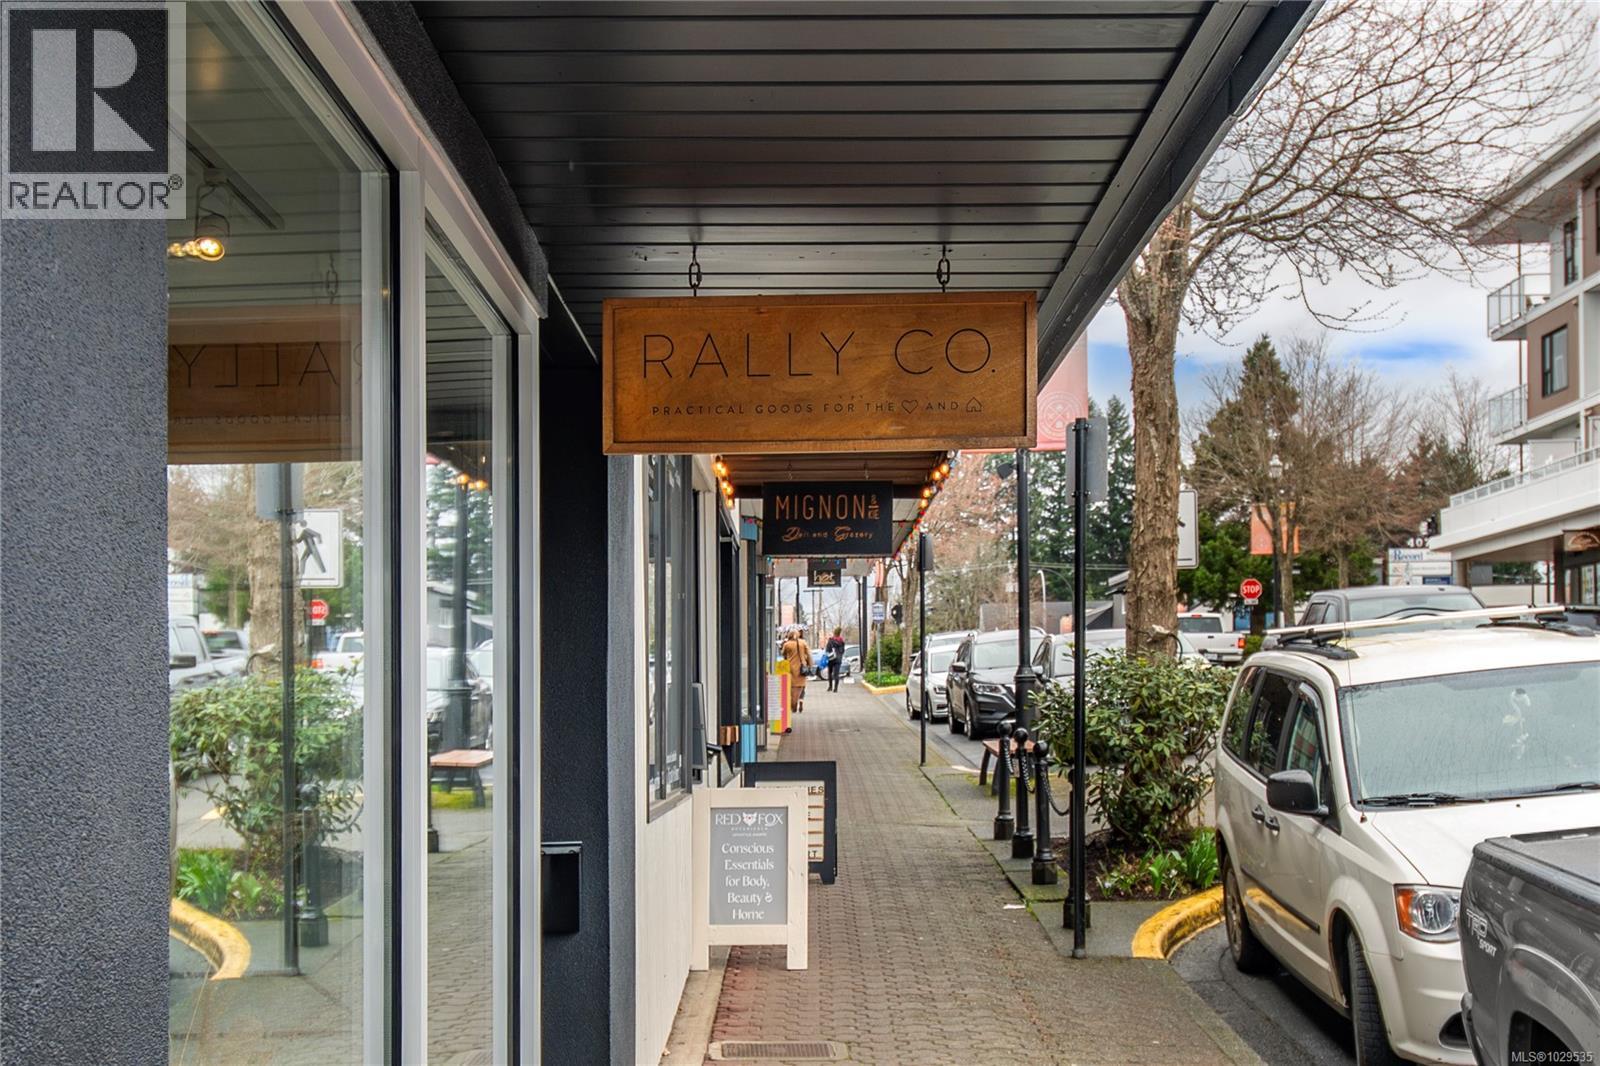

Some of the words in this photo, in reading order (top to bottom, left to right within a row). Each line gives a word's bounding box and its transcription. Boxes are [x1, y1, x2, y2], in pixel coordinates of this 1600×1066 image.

[643, 331, 855, 379] RALLY
[894, 328, 996, 375] CO.
[652, 405, 745, 416] PRACTICAL
[755, 403, 813, 415] GOODS
[823, 403, 856, 413] FOR
[865, 402, 896, 412] THE
[926, 402, 959, 412] AND
[775, 494, 865, 520] MIGNON
[1243, 585, 1260, 594] STOP
[715, 813, 741, 825] RED
[758, 813, 784, 827] FOX
[721, 843, 775, 854] Conscious
[724, 858, 775, 870] Essentials
[725, 876, 741, 887] for
[727, 892, 761, 906] Beauty
[732, 908, 765, 920] Home
[1480, 939, 1497, 957] SPORT
